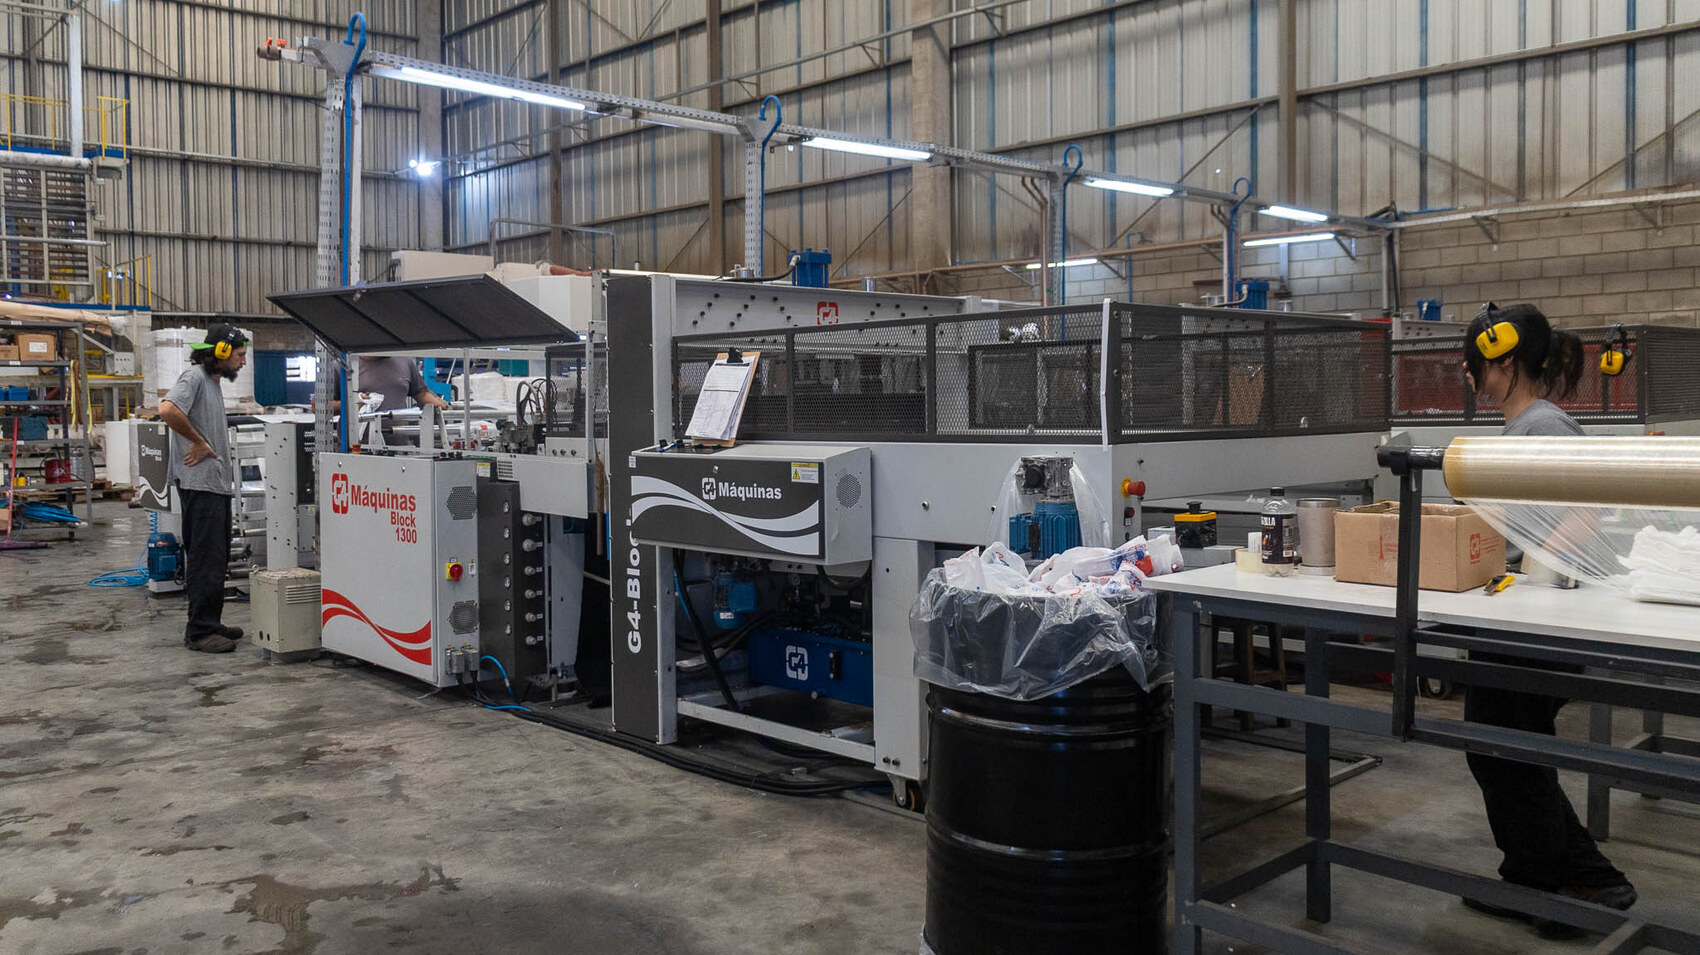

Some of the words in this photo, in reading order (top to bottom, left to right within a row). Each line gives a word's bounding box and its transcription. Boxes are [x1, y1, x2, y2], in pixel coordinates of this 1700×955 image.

[351, 484, 417, 514] Máquinas
[718, 481, 782, 501] Máquinas
[390, 511, 416, 528] Block
[395, 527, 417, 544] 1300
